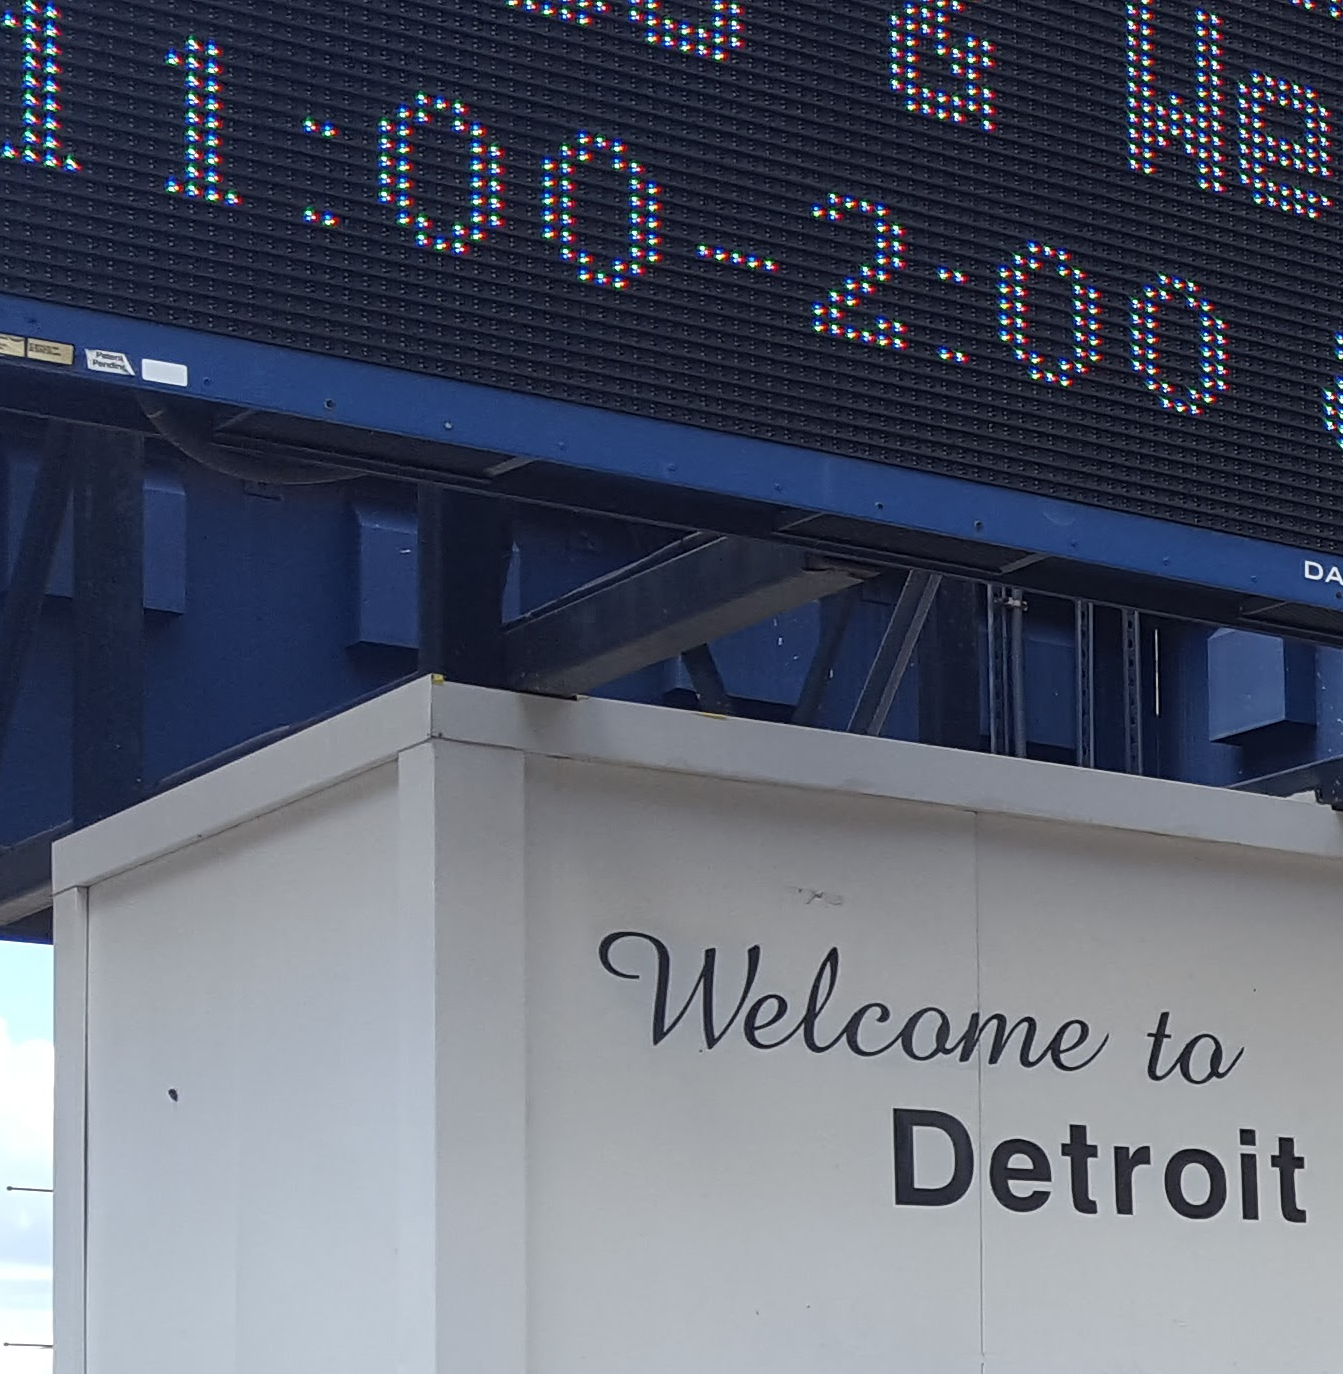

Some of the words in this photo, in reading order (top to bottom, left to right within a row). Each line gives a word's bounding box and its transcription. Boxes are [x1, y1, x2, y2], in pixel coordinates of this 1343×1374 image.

[599, 931, 1109, 1073] Welcome
[1145, 1011, 1244, 1085] to
[892, 1107, 1307, 1223] Detroit
